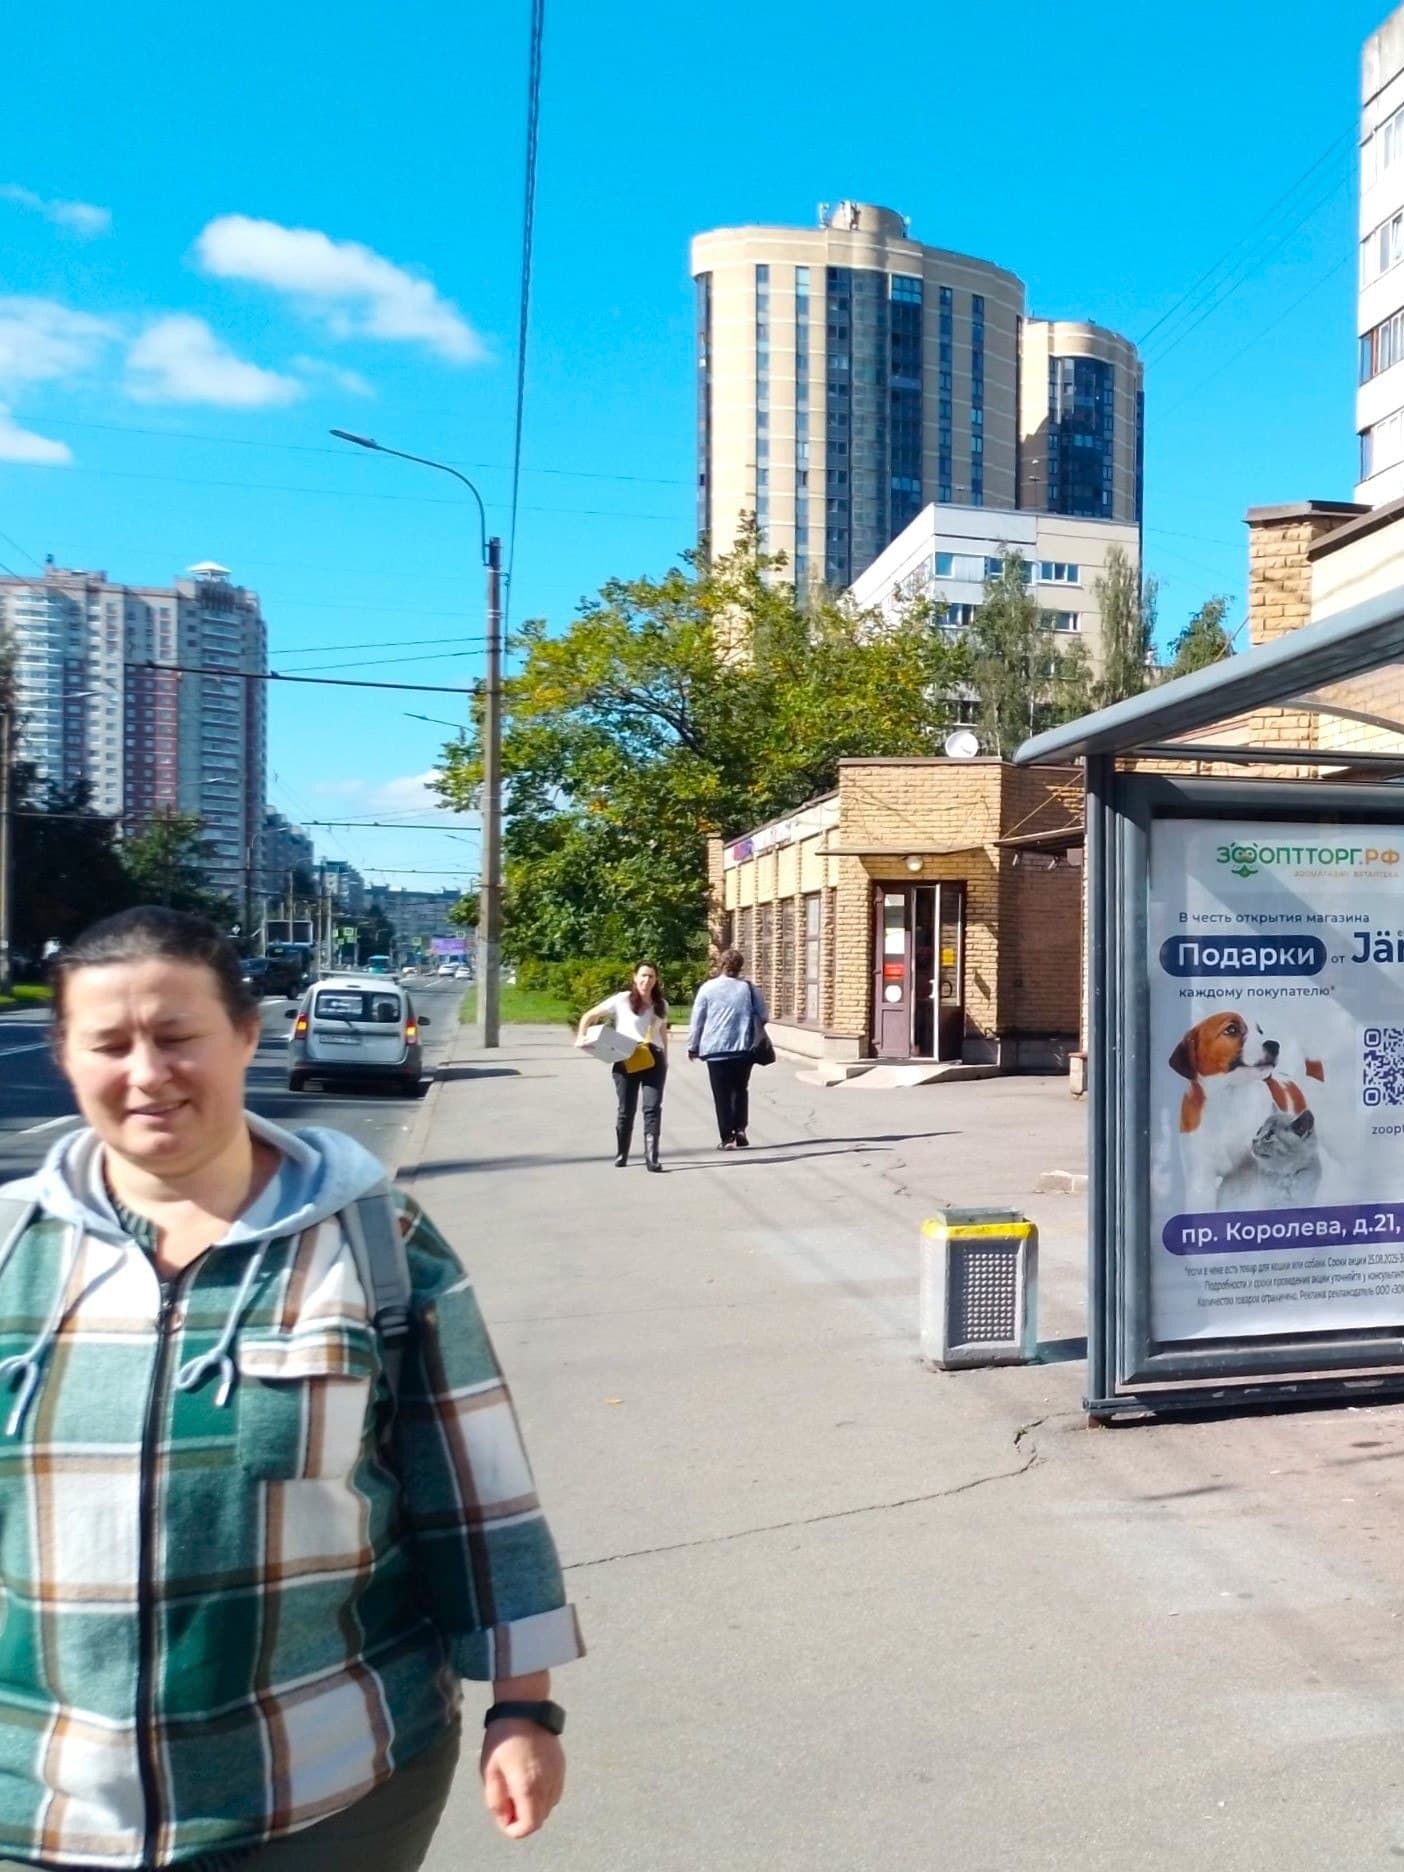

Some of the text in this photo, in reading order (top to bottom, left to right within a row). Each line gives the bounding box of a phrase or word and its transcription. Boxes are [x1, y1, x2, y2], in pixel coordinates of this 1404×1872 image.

[1178, 912, 1370, 926] В честь открытия магазина
[1178, 943, 1315, 971] Подарки
[1331, 955, 1346, 964] от
[1179, 985, 1243, 999] каждому
[1182, 1228, 1218, 1247] пр.
[1226, 1220, 1346, 1243] Королева,
[1353, 1213, 1401, 1236] д.21,
